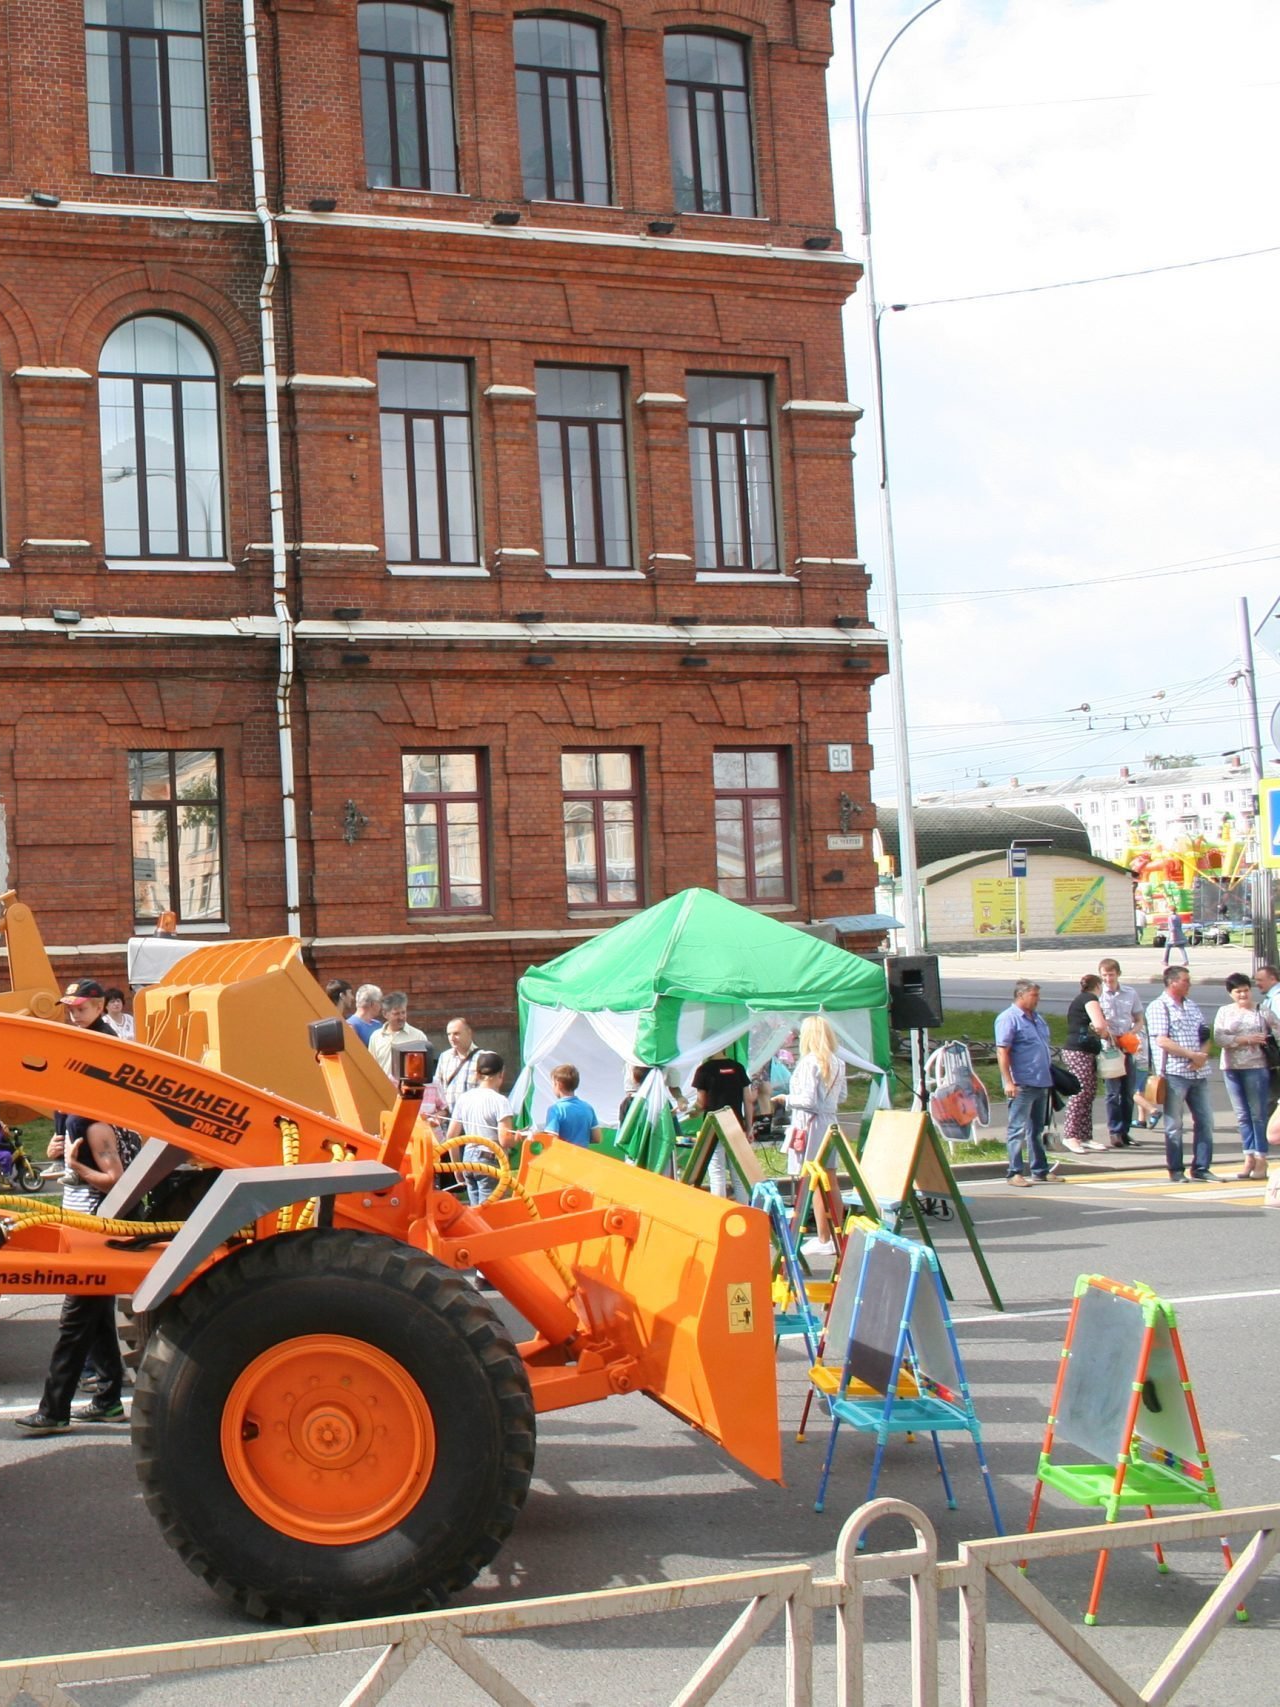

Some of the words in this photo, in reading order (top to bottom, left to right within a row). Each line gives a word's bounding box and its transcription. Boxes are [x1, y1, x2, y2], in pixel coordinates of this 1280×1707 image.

[831, 749, 849, 767] 93
[113, 1063, 251, 1124] РЫБИНЕЦ
[191, 1118, 240, 1144] DM-14
